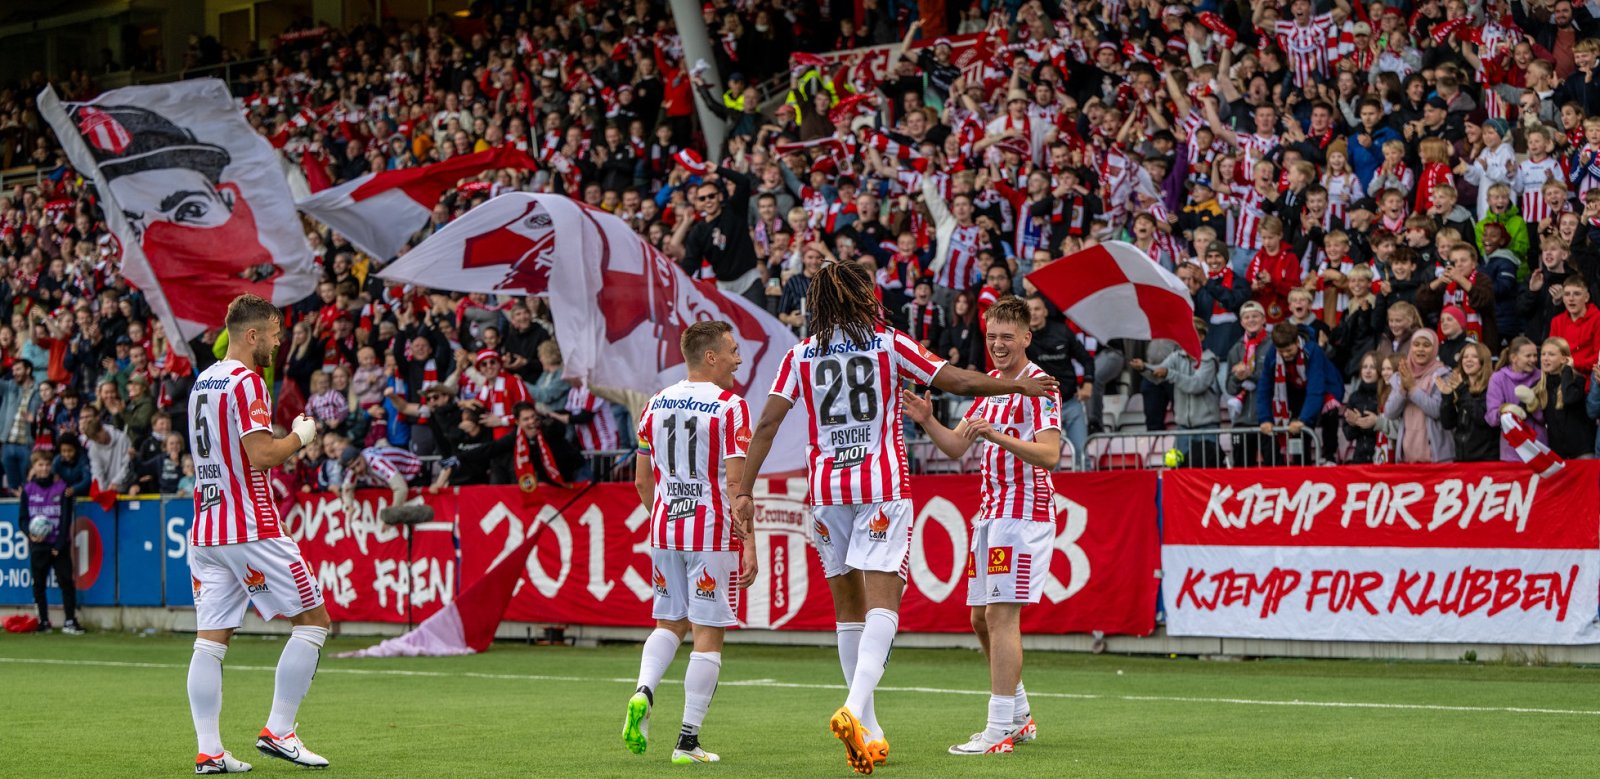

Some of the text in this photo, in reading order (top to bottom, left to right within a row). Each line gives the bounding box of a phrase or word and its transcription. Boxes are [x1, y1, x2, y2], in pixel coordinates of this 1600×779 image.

[651, 395, 720, 414] Ishavskraft
[815, 356, 878, 426] 28
[195, 393, 211, 458] 5
[662, 413, 698, 479] 11
[831, 427, 871, 446] PSYCHÉ
[833, 446, 868, 463] MOT
[668, 499, 697, 515] MOT
[1202, 474, 1539, 535] KJEMP FOR BYEN
[75, 530, 89, 577] 1
[1176, 566, 1578, 621] KJEMP FOR KLUBBEN
